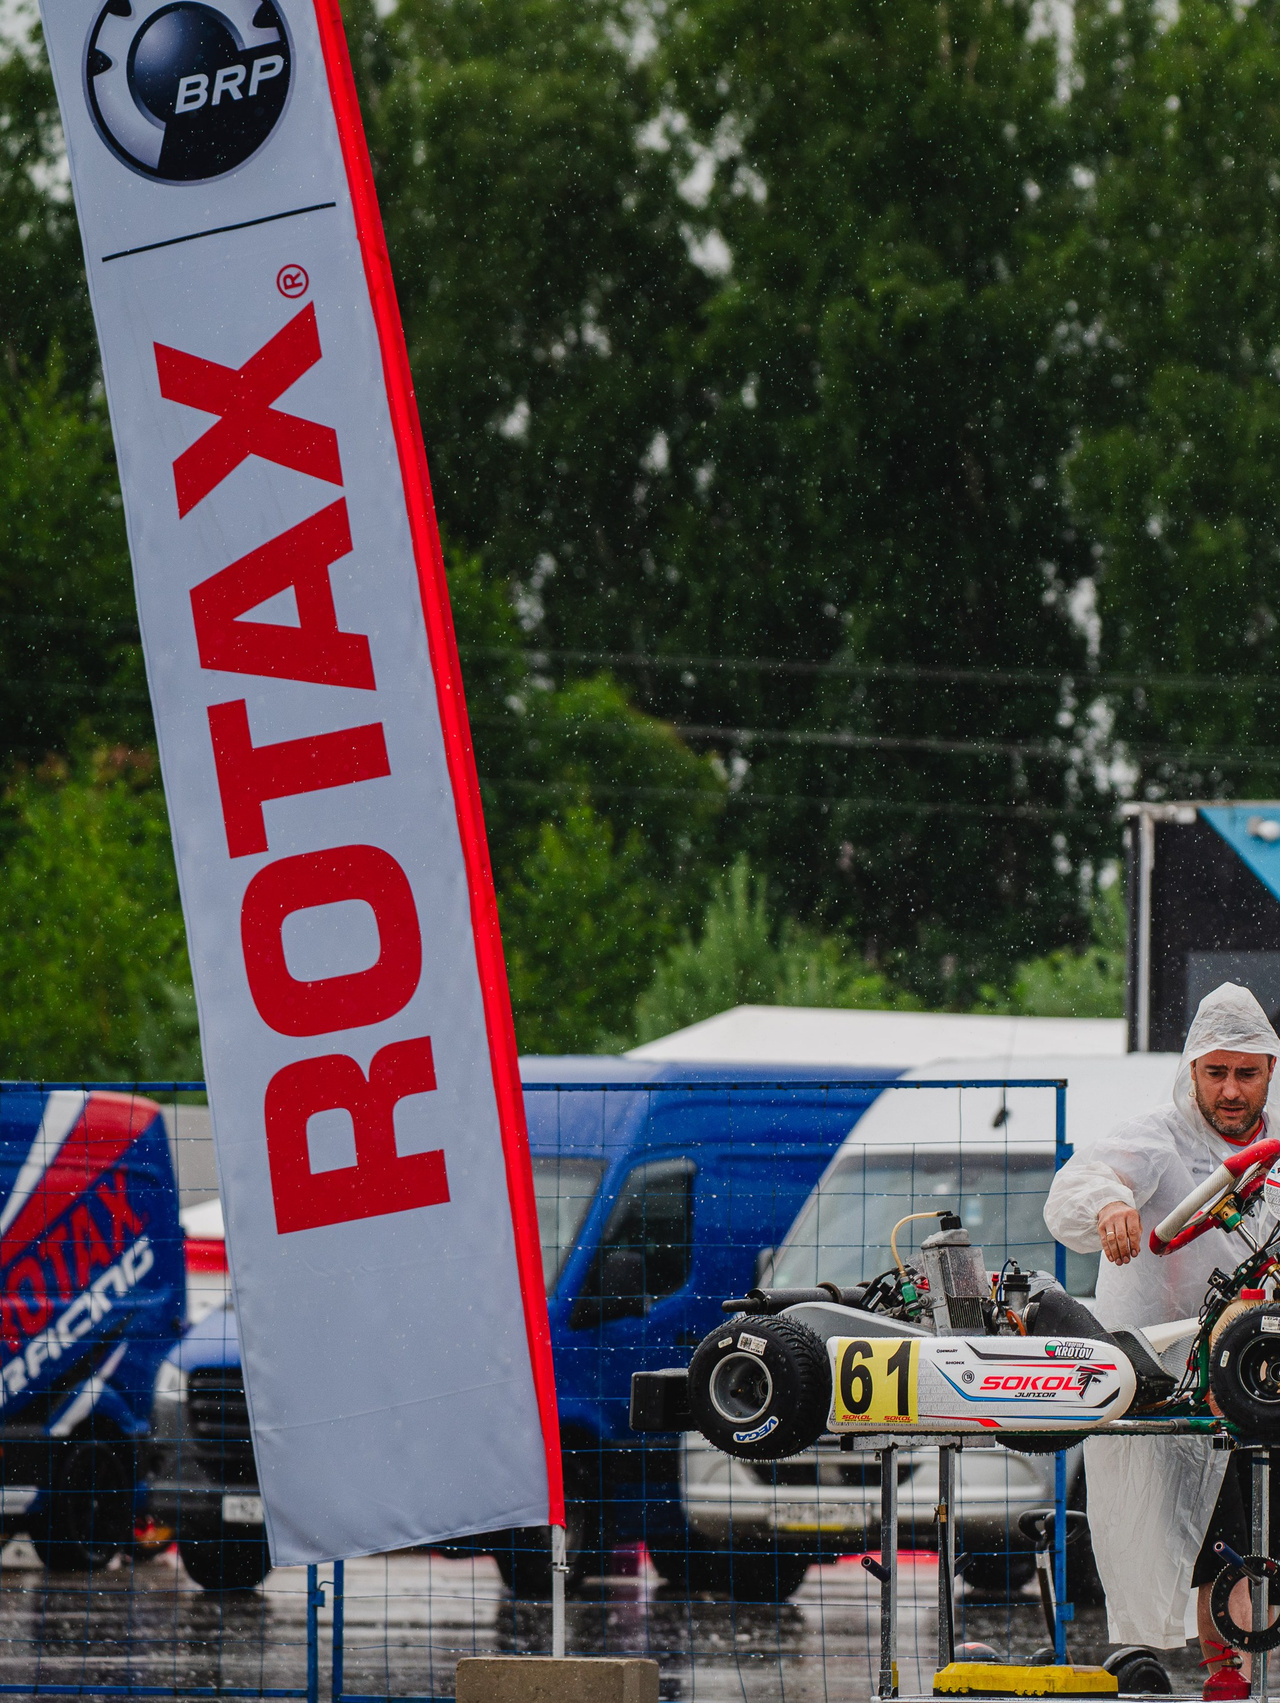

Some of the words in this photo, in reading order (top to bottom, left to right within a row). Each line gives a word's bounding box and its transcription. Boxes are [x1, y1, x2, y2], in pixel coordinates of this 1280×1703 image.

[175, 55, 284, 115] BRP
[153, 300, 450, 1235] ROTAX
[0, 1235, 155, 1408] RACING
[841, 1340, 912, 1416] 61
[1054, 1345, 1094, 1360] KROTOV
[980, 1376, 1083, 1391] SOKOL
[735, 1418, 778, 1441] VEGA
